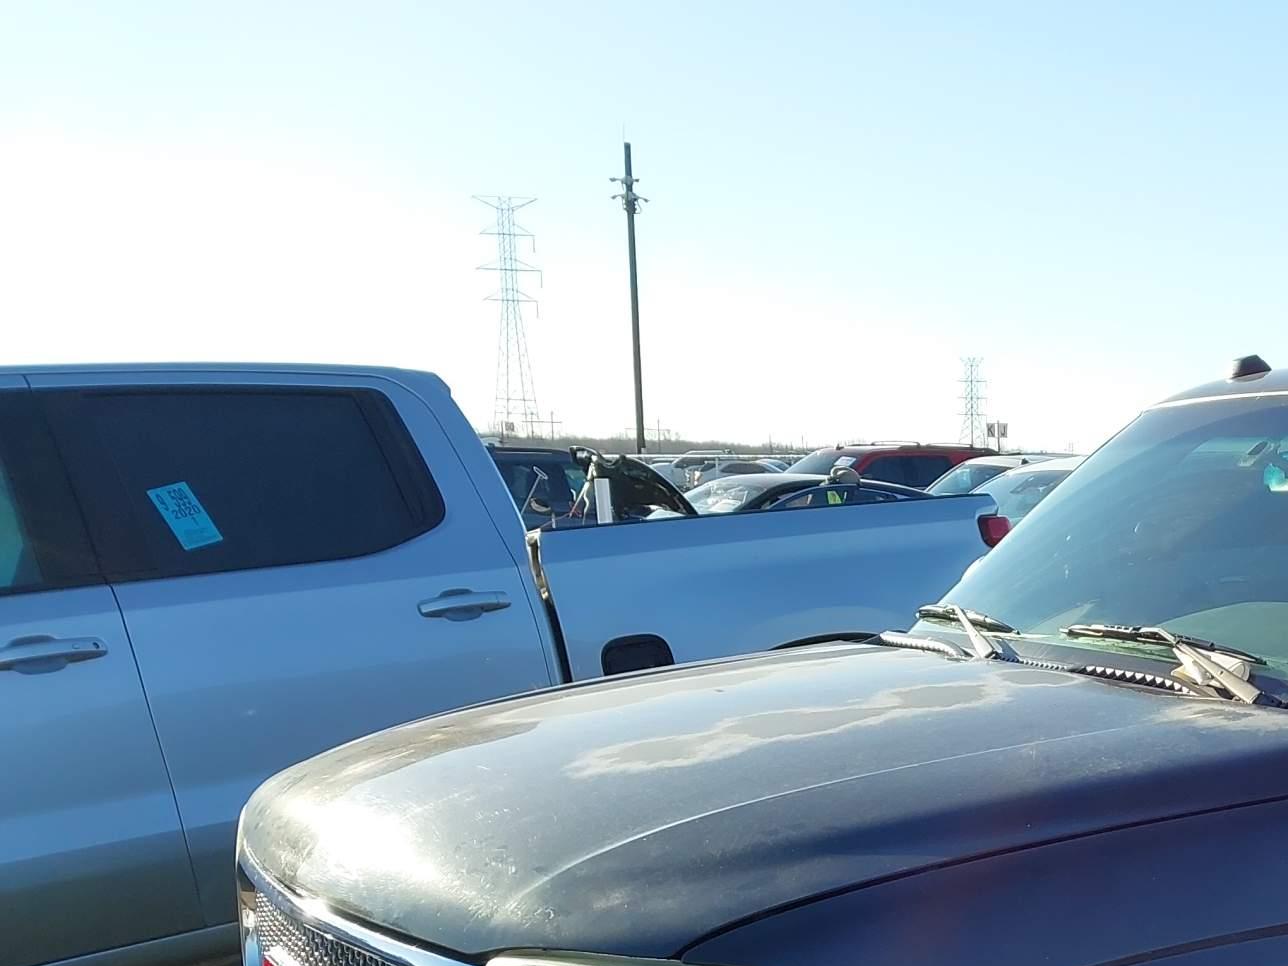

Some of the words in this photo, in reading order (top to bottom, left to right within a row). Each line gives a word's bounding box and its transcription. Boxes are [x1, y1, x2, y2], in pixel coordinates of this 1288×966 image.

[986, 423, 995, 437] K
[1000, 424, 1006, 437] J
[171, 503, 201, 520] 2020
